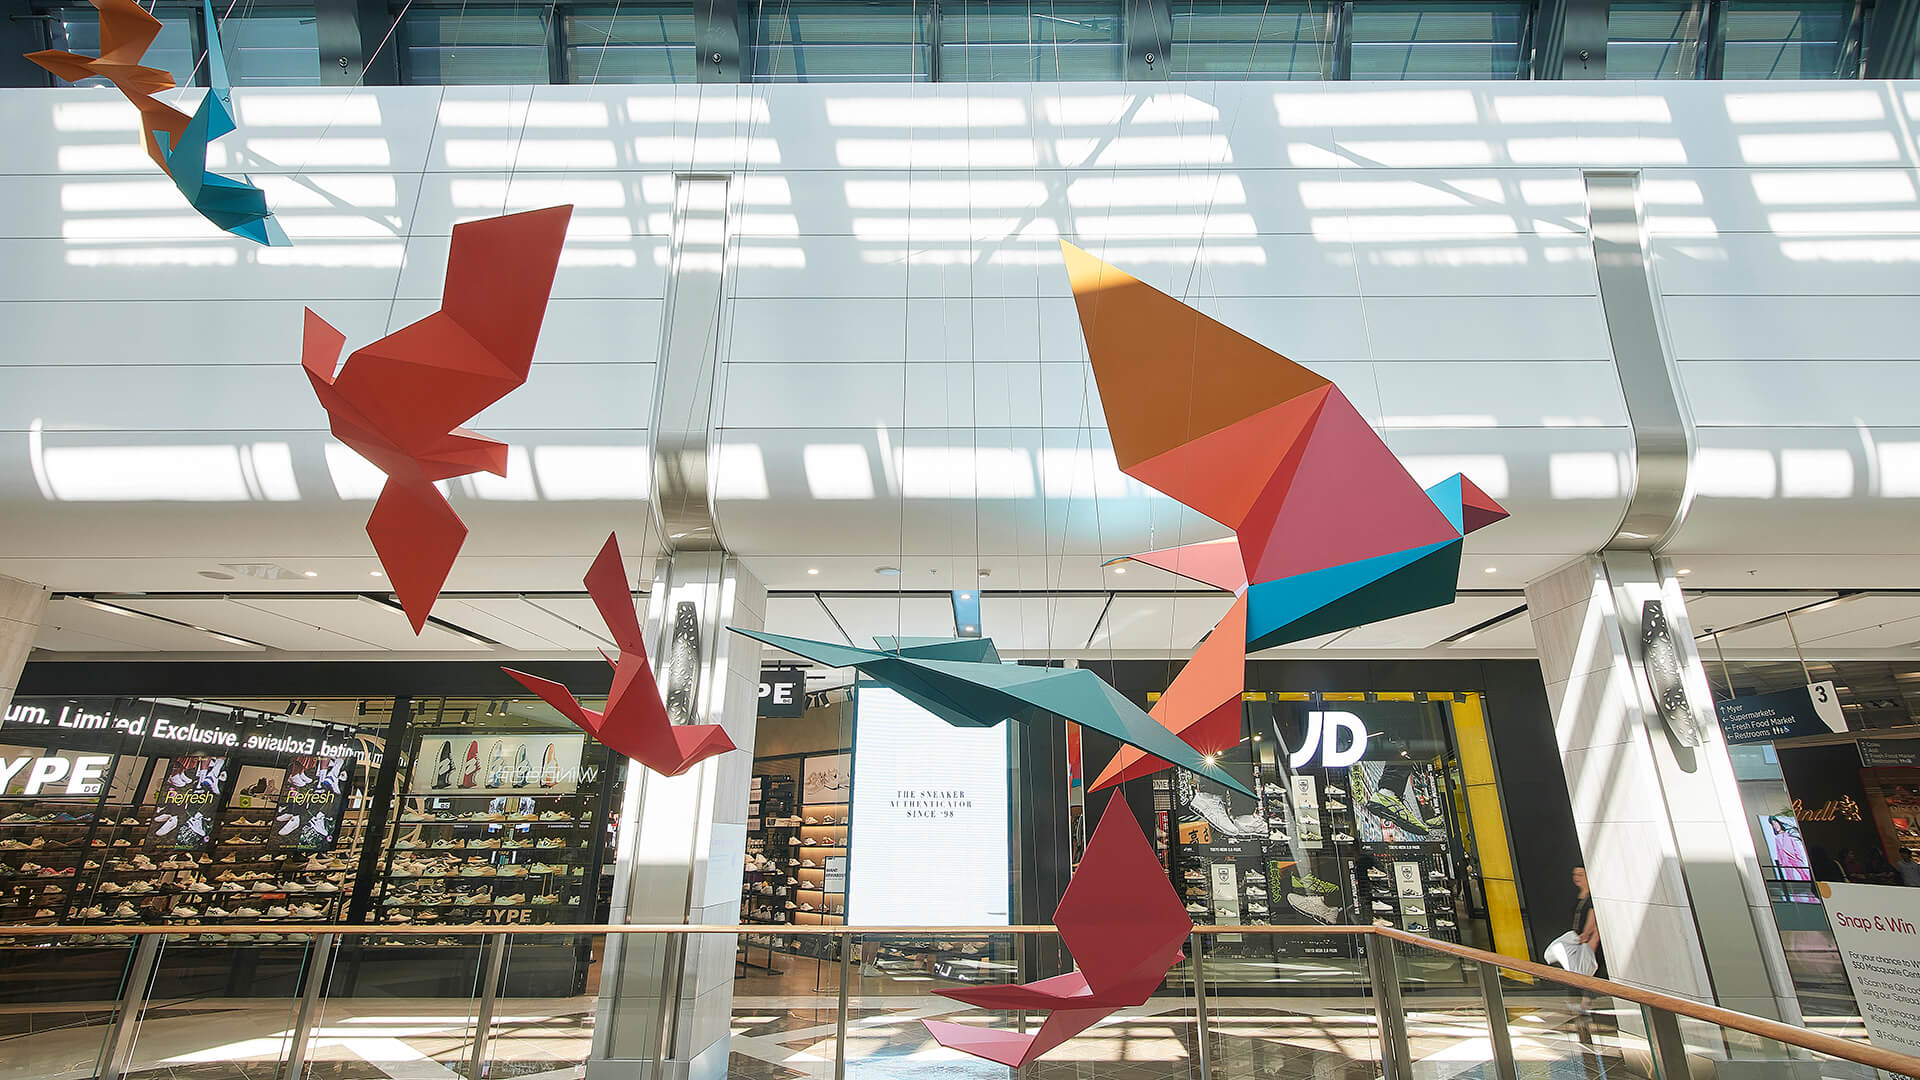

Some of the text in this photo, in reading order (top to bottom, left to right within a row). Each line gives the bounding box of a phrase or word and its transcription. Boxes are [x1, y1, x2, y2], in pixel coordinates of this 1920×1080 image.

[1815, 686, 1828, 703] 3
[1726, 704, 1743, 715] Myer
[1730, 708, 1776, 722] Supermarkets
[1732, 715, 1796, 731] Fresh Food Market
[152, 719, 240, 747] Exclusive.
[1290, 711, 1368, 769] JD
[1734, 730, 1771, 740] Restrooms
[84, 785, 99, 793] DC
[164, 790, 214, 806] Refresh
[286, 790, 335, 806] Refresh
[907, 810, 936, 818] SINCE
[1836, 912, 1917, 935] Snap & Win
[1848, 951, 1859, 959] For
[1859, 954, 1875, 962] your
[1876, 956, 1902, 966] chance
[1901, 959, 1910, 967] to
[1852, 961, 1865, 970] $50
[1866, 963, 1902, 976] Macquarie
[1864, 977, 1881, 987] Scan
[1881, 980, 1894, 990] the
[1894, 983, 1905, 993] QR
[1873, 1004, 1888, 1016] Tag
